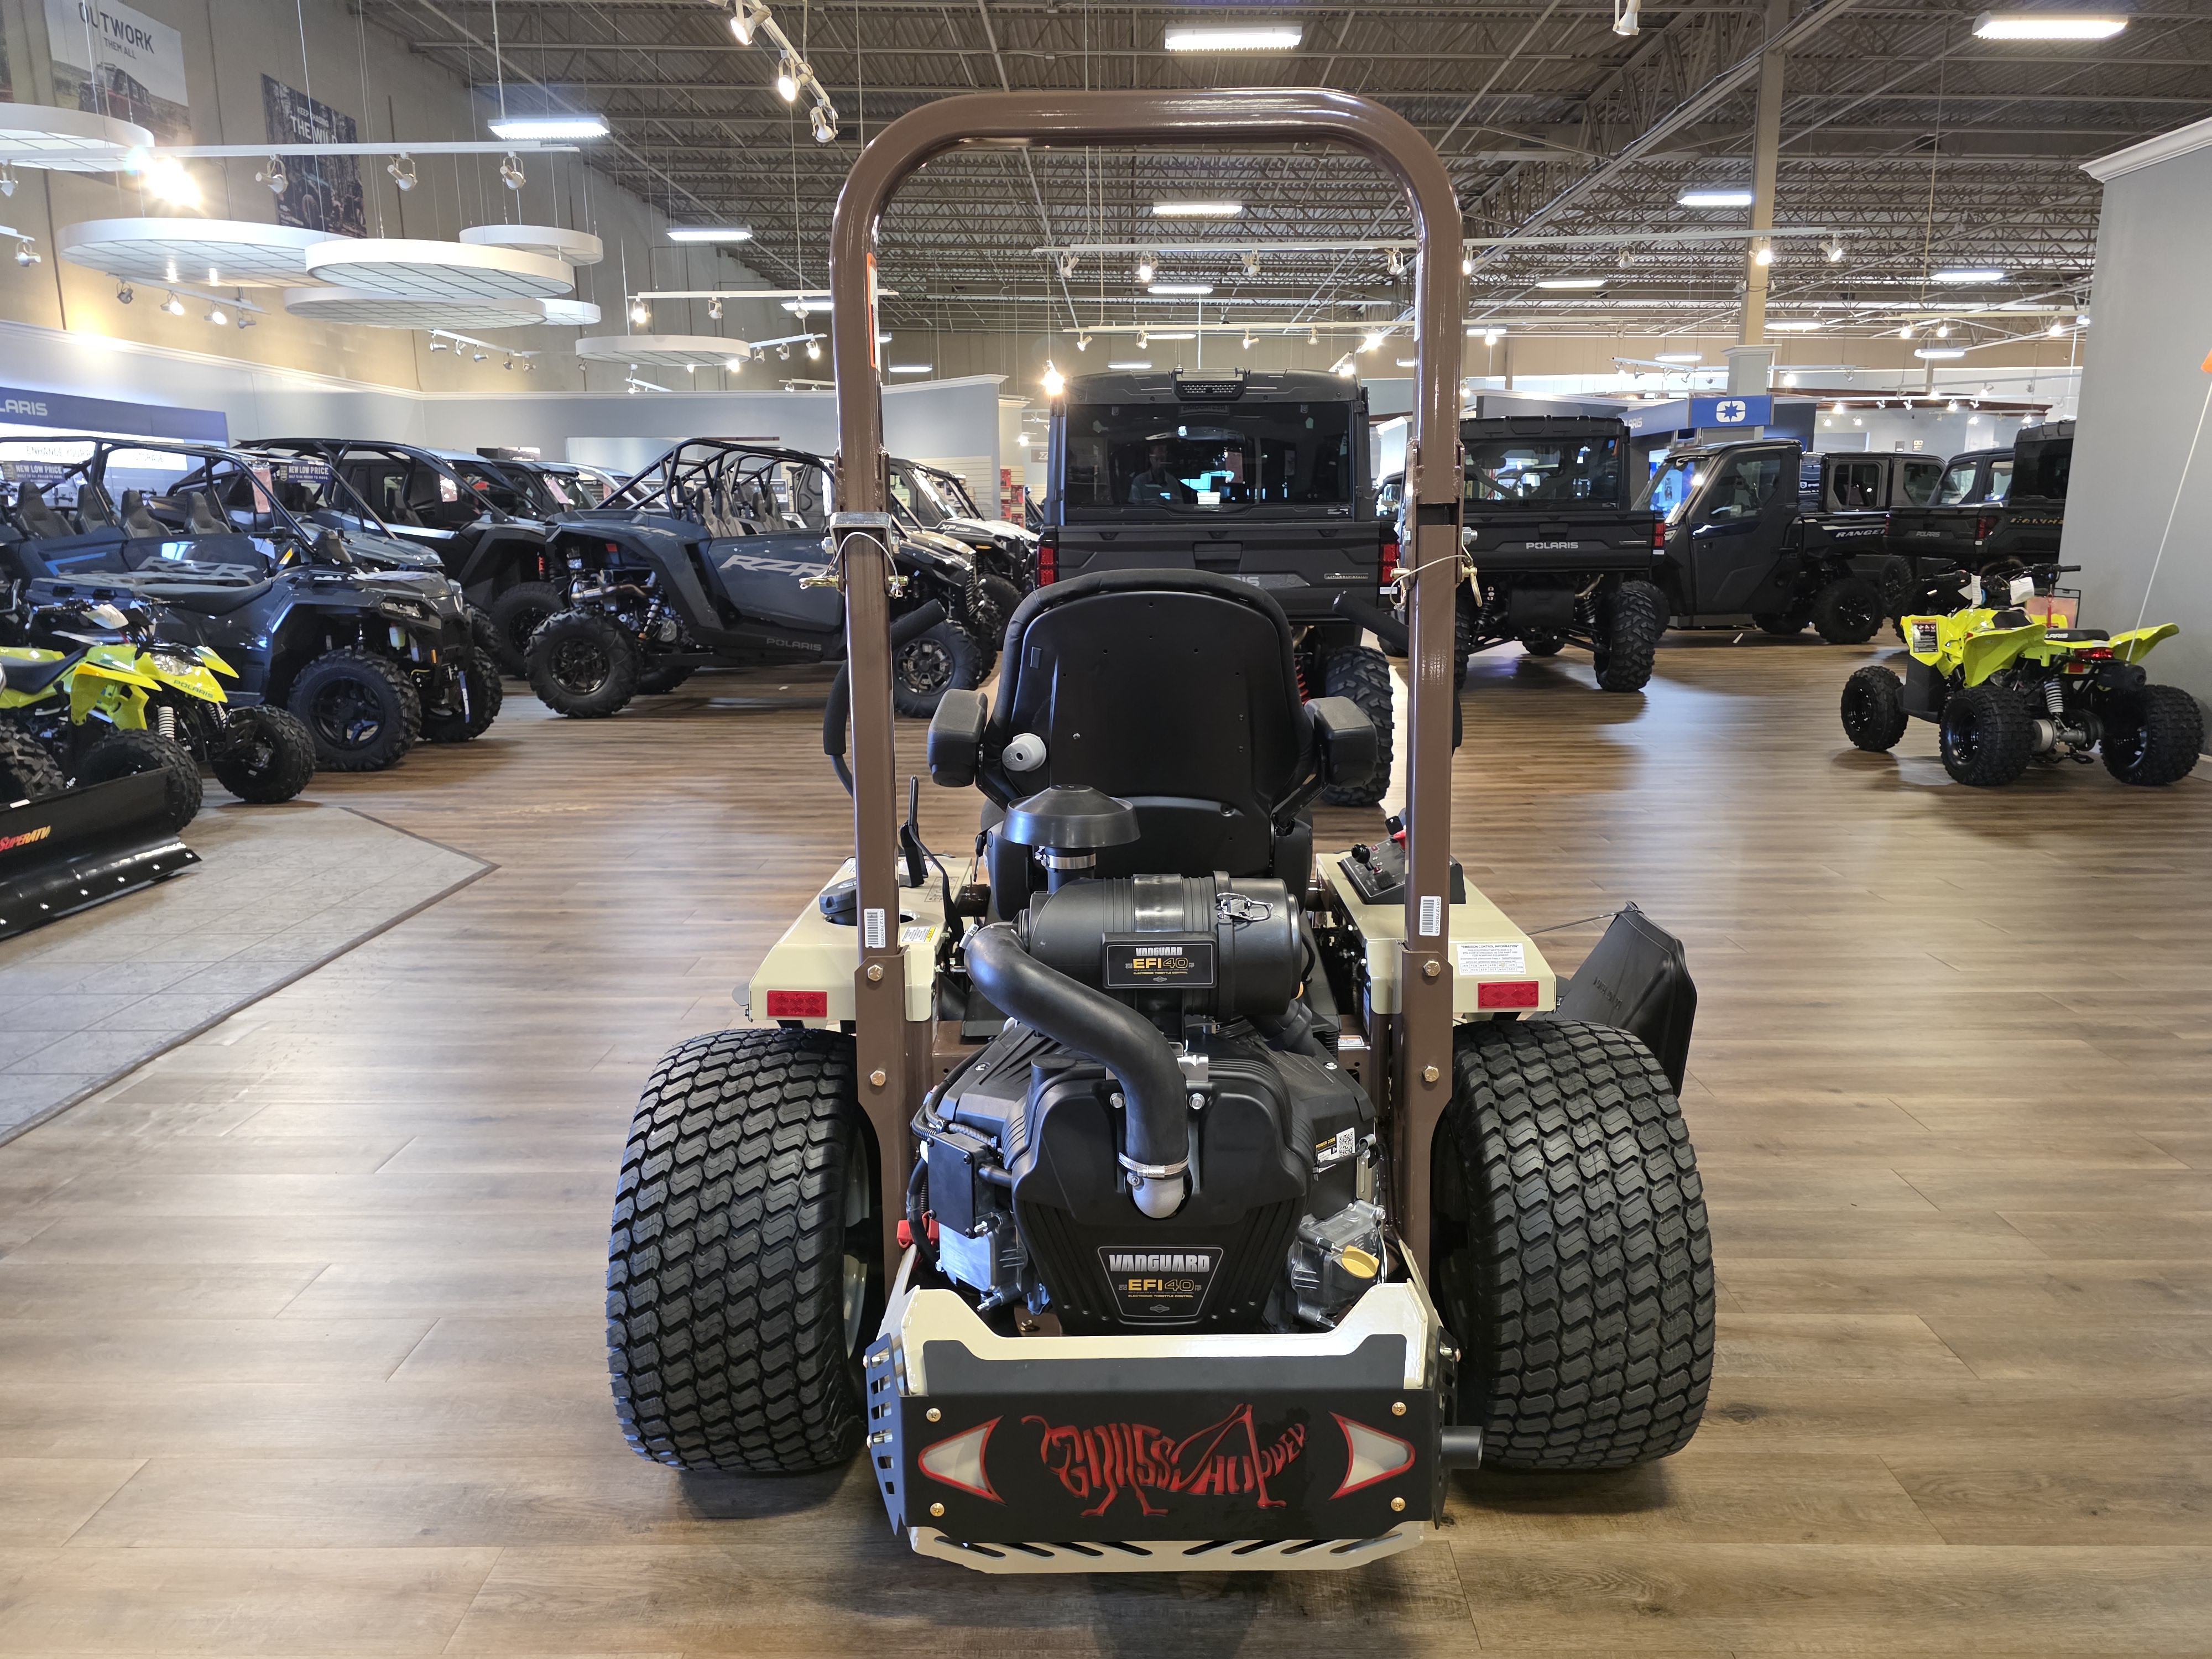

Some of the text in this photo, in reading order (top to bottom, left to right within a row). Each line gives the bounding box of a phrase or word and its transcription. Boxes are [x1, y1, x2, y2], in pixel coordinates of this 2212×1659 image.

[79, 2, 154, 54] OUTWORK
[103, 36, 137, 60] THEM ALL
[296, 106, 309, 118] KEEP
[290, 114, 312, 140] THE
[15, 464, 29, 473] NEW
[30, 465, 44, 474] LOW
[45, 466, 62, 474] PRICE
[289, 466, 299, 474] NEW
[310, 467, 329, 475] PRICE
[136, 555, 258, 586] RZR
[718, 554, 836, 577] RZR
[766, 638, 822, 651] POLARIS
[173, 680, 214, 698] POLARIS
[1135, 947, 1183, 956] VANGUARD
[1109, 1254, 1210, 1272] VANGUARD
